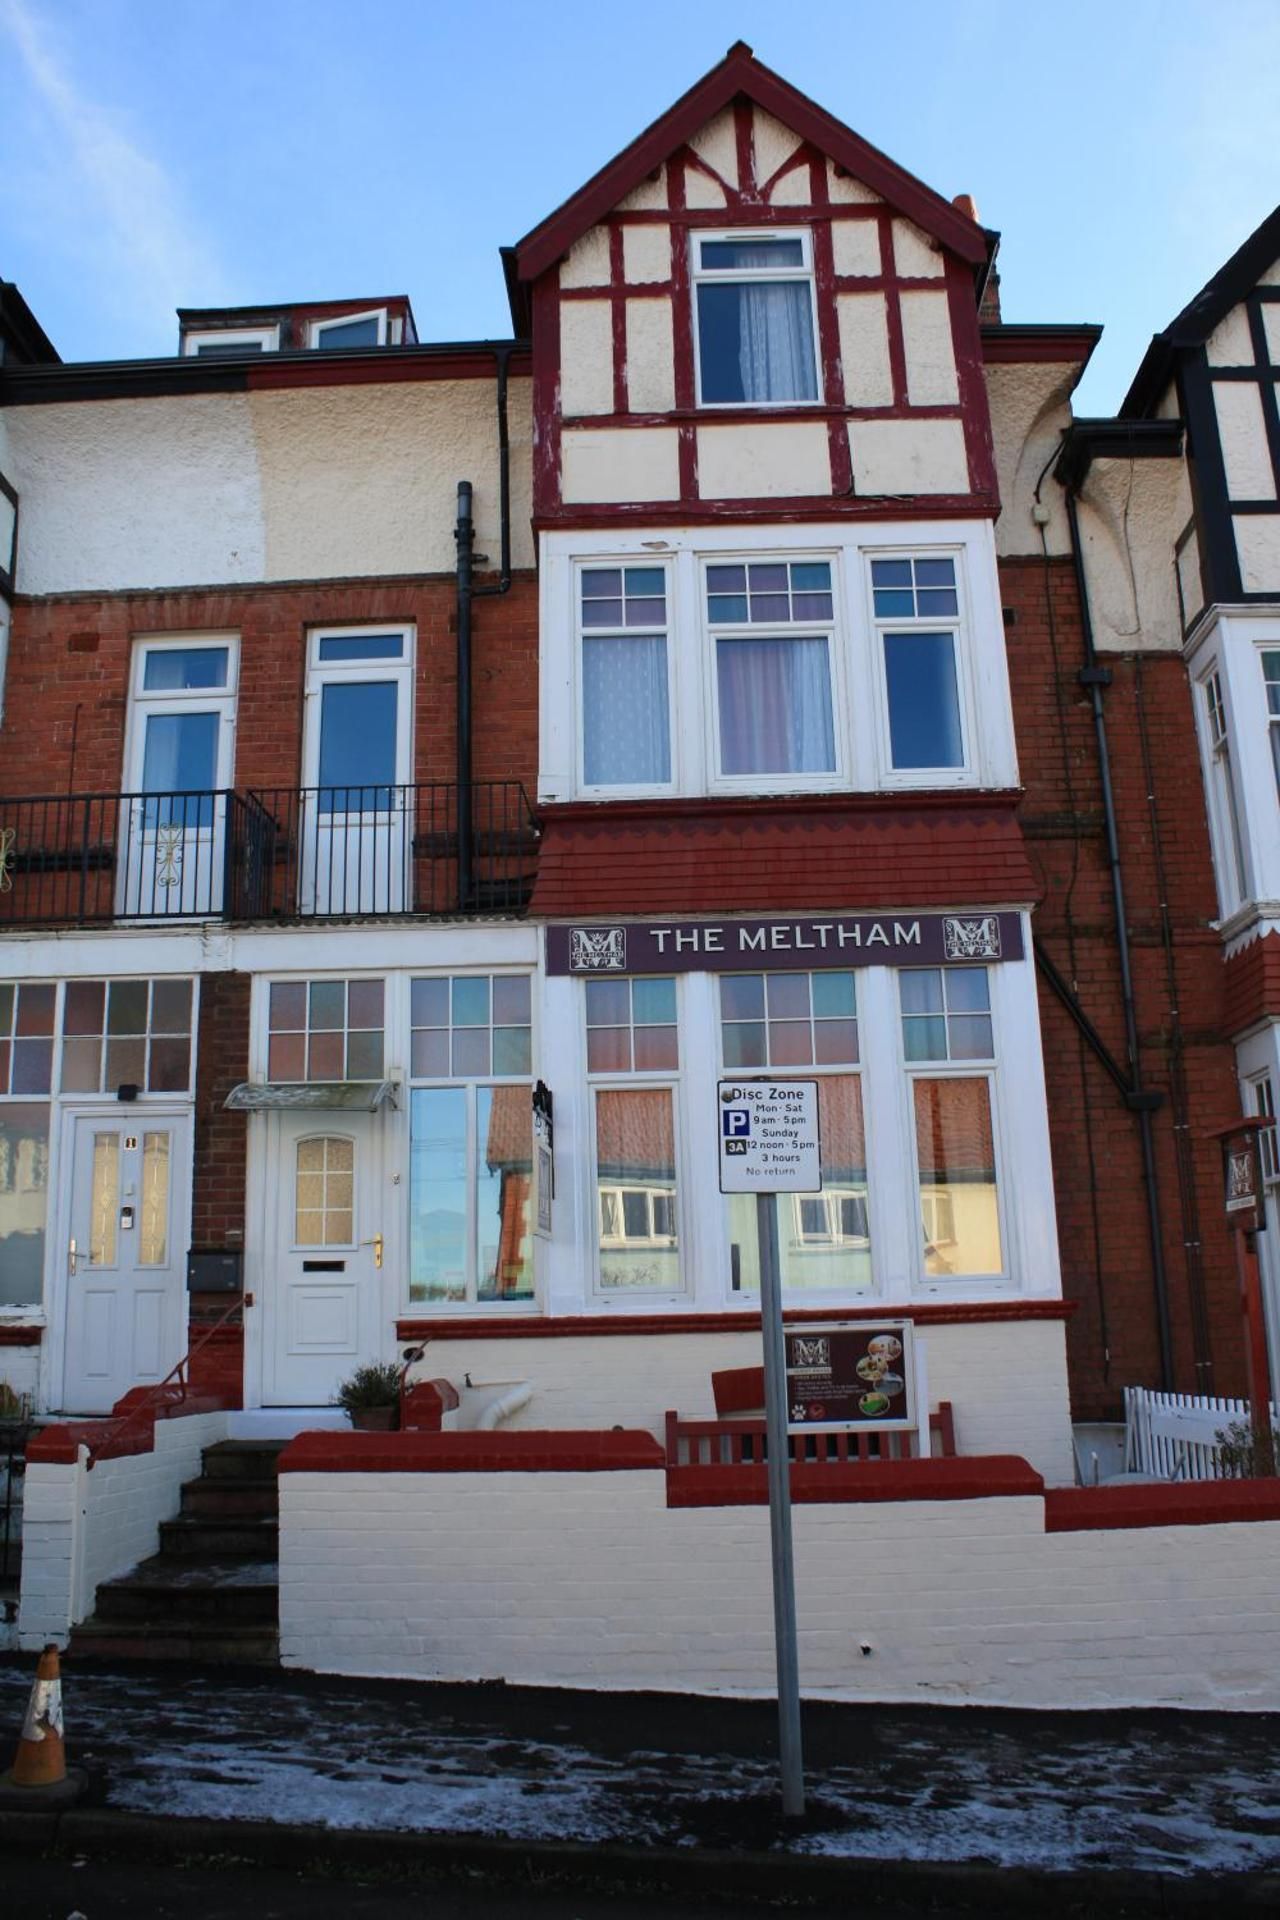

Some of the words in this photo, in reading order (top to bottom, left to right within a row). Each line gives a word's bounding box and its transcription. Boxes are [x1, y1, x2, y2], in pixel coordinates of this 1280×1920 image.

[649, 928, 725, 953] THE
[739, 921, 922, 951] MELTHAM
[732, 1088, 762, 1100] Disc
[769, 1088, 804, 1099] Zone
[756, 1104, 778, 1112] Mon
[786, 1104, 803, 1112] Sat
[729, 1112, 746, 1135] P
[762, 1129, 799, 1138] Sunday
[728, 1142, 745, 1152] 3A
[747, 1141, 757, 1149] 12
[762, 1154, 768, 1162] 3
[772, 1154, 800, 1162] hours
[765, 1167, 795, 1175] return
